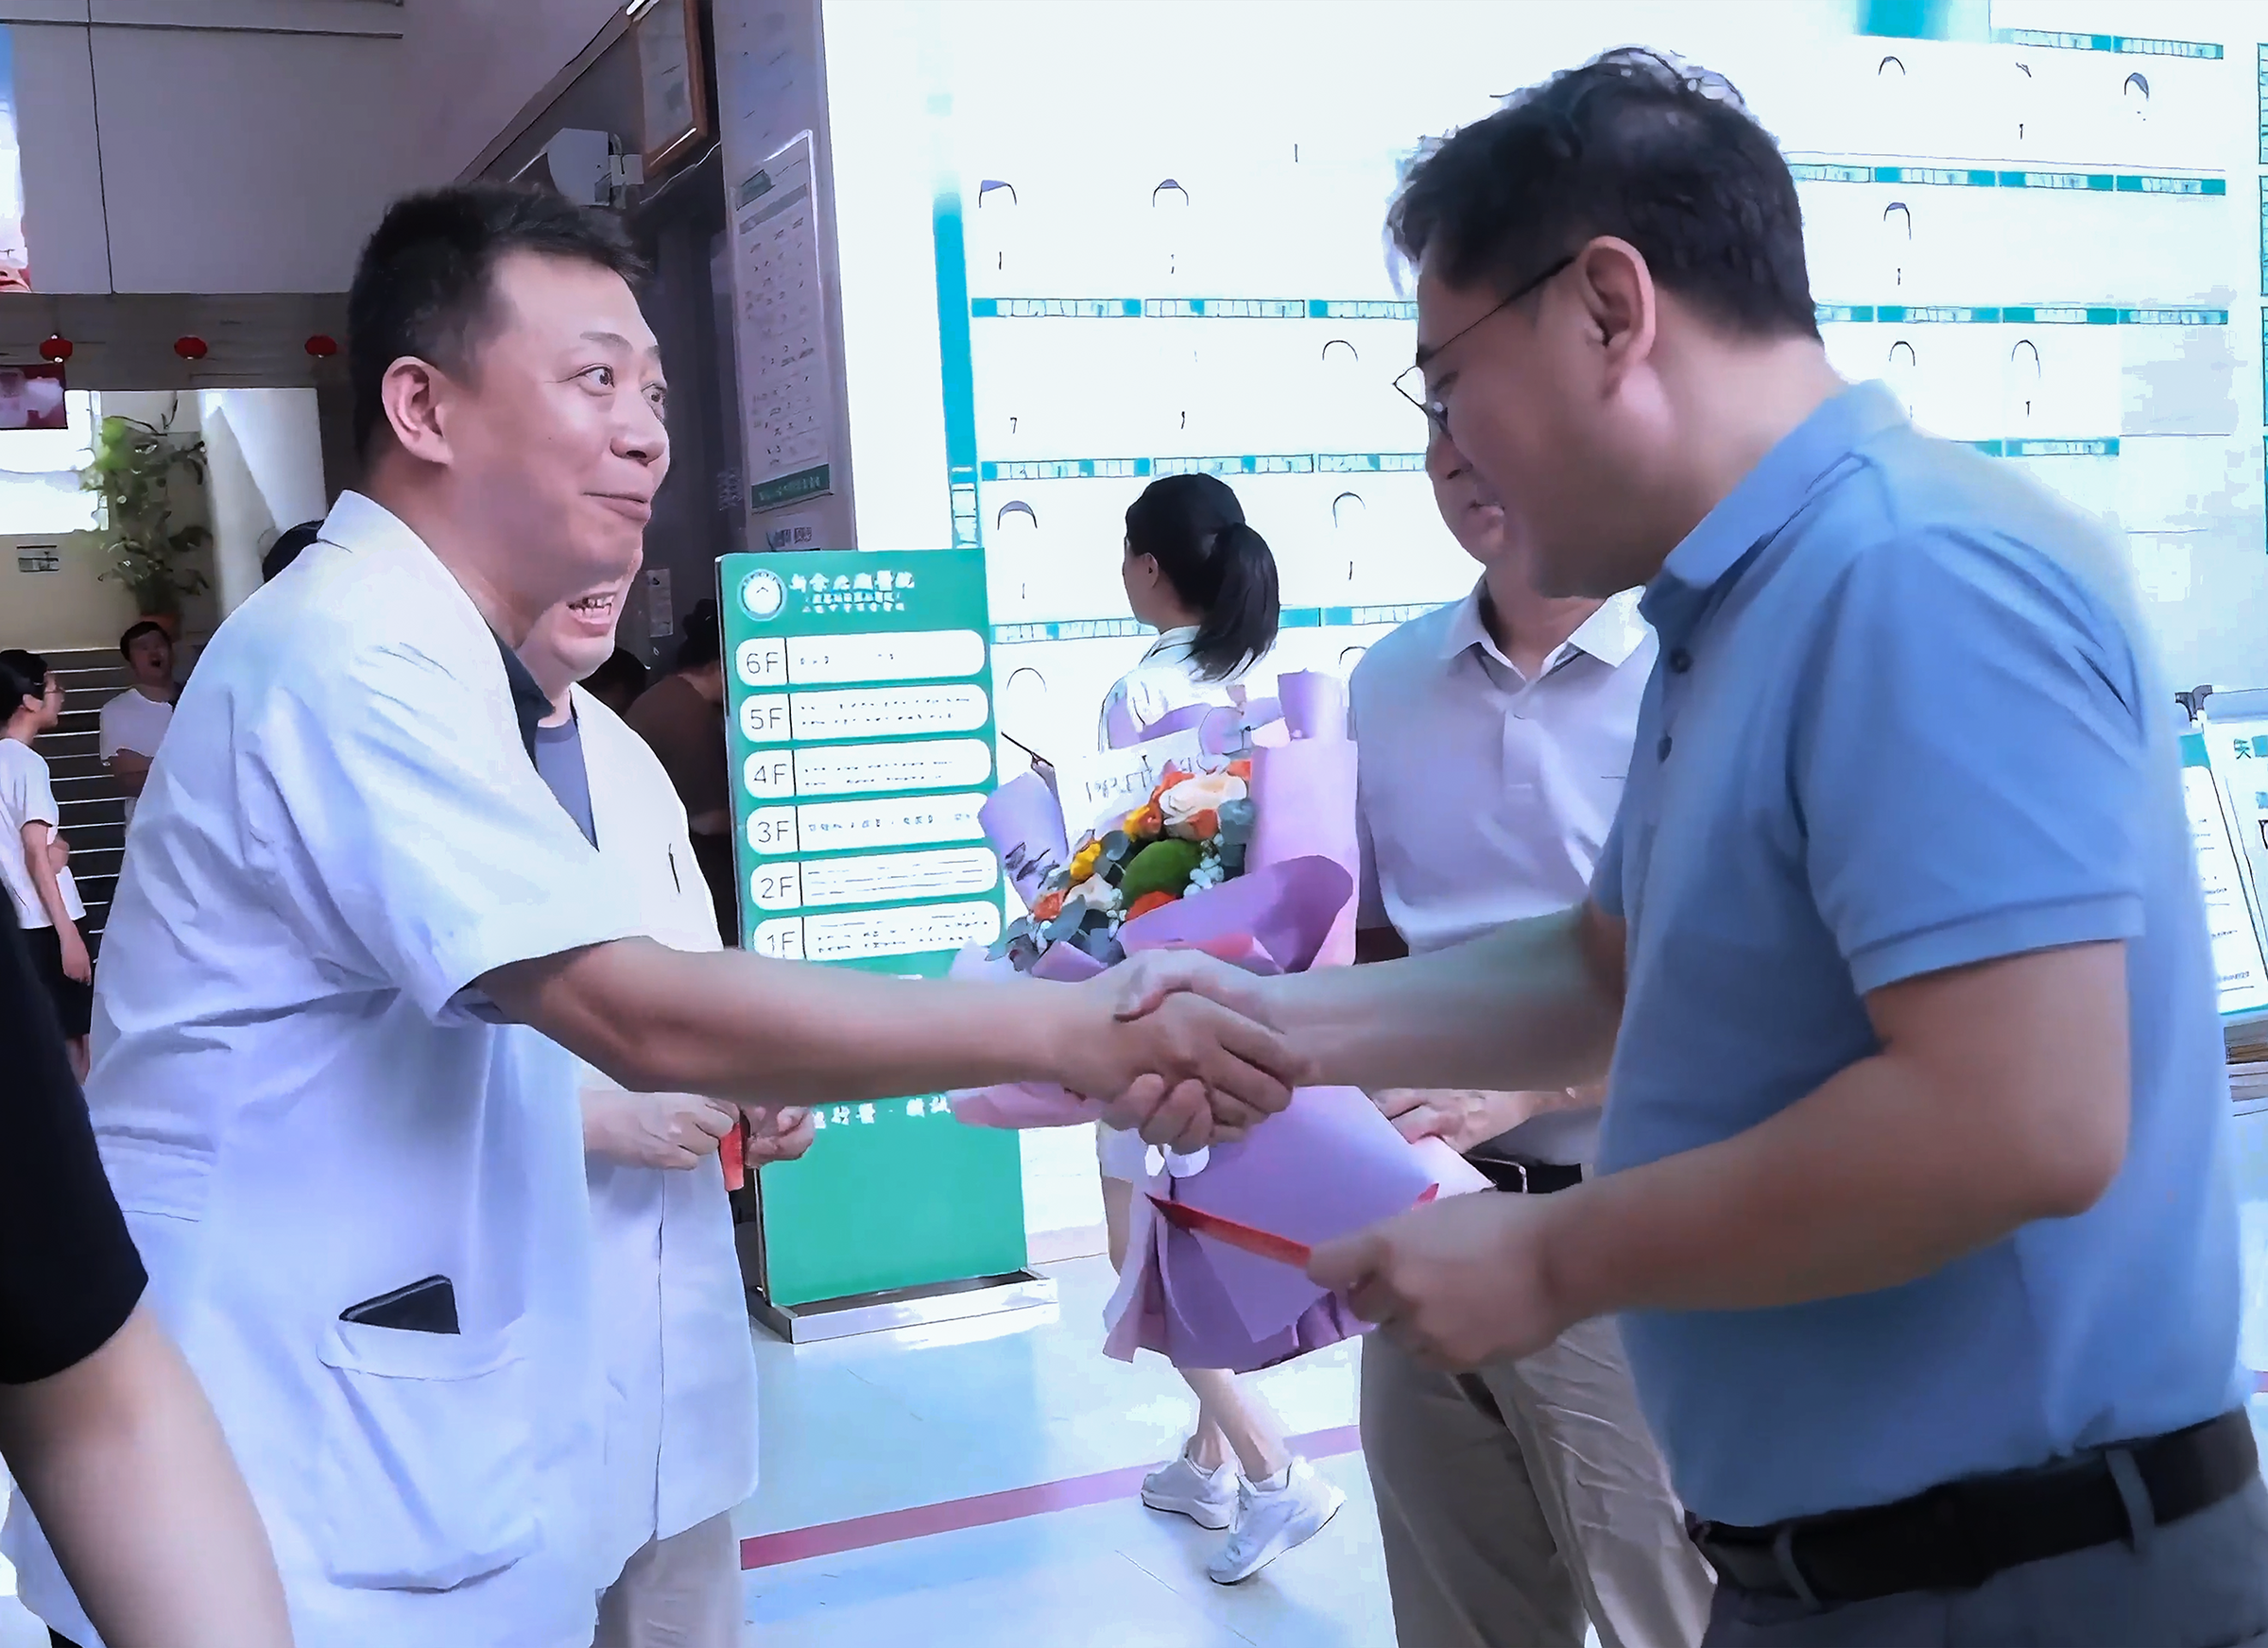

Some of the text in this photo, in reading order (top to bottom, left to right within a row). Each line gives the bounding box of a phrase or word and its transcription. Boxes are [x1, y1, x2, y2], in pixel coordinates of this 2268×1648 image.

[747, 652, 779, 674] 6F
[750, 708, 782, 730] 5F
[753, 764, 787, 785] 4F
[757, 821, 790, 844] 3F
[760, 876, 795, 899] 2F
[766, 931, 796, 955] 1F
